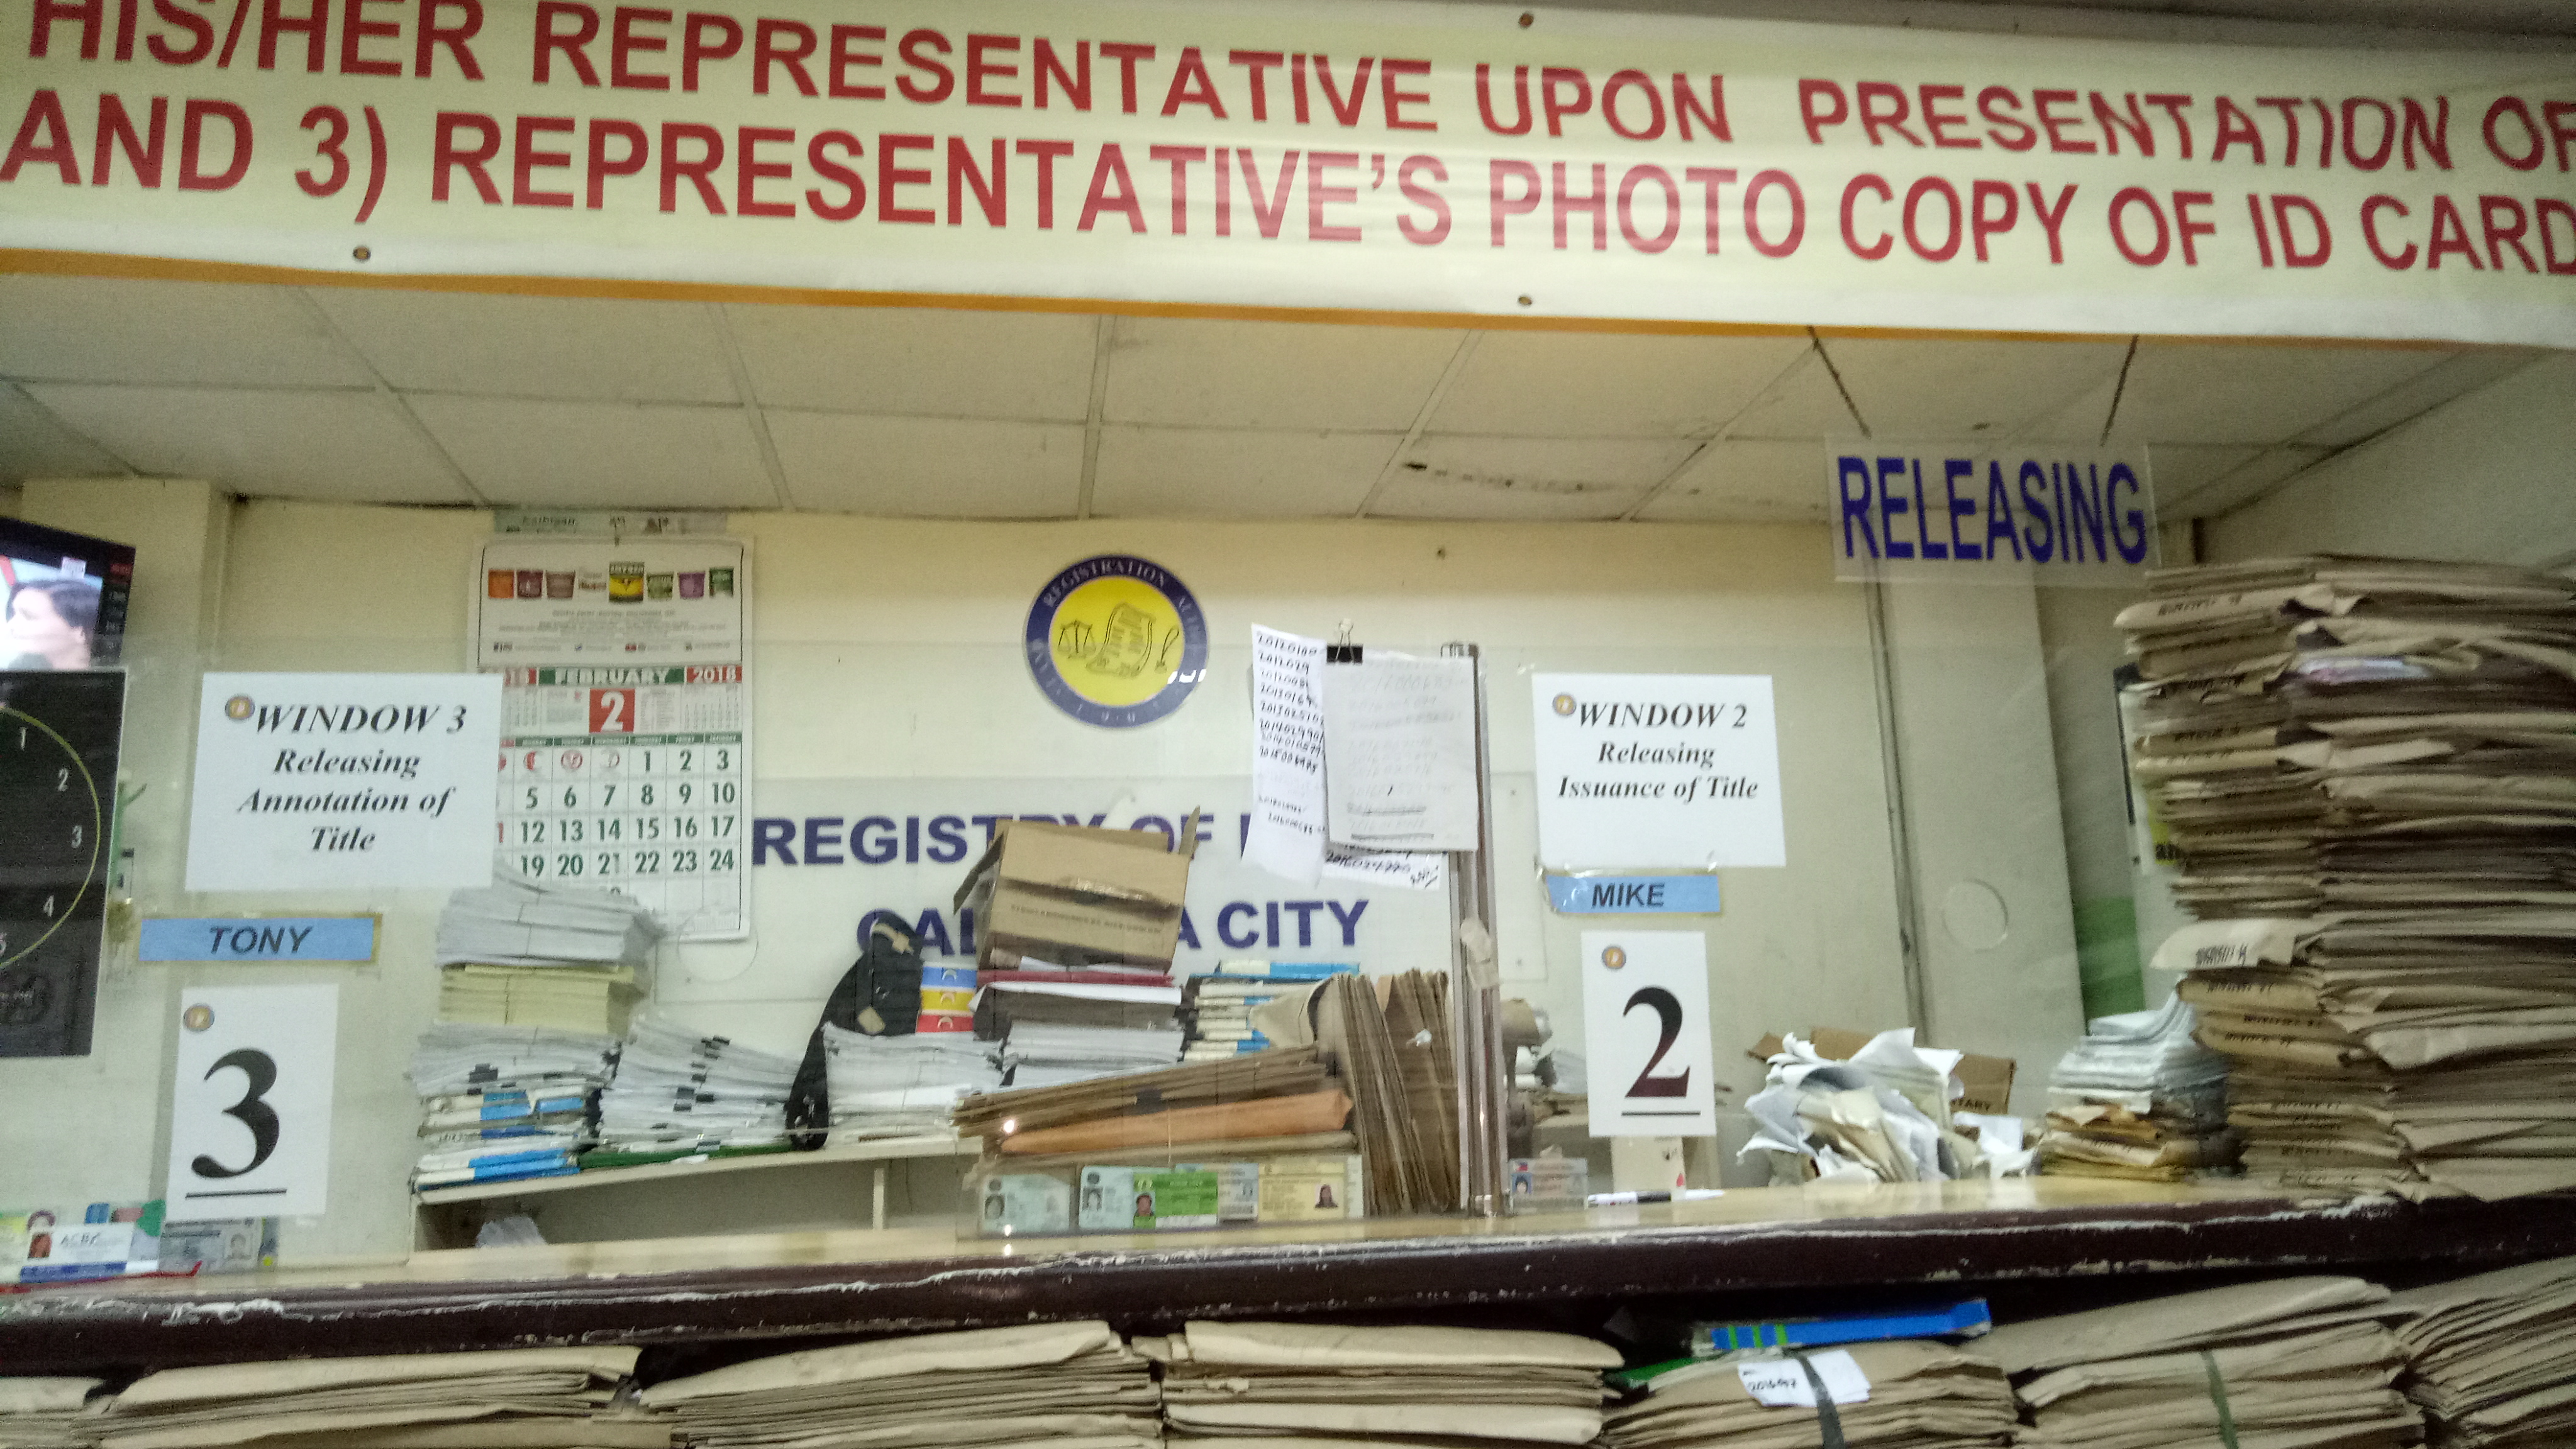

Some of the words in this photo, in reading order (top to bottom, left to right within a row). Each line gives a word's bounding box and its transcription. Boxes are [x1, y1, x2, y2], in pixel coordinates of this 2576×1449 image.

[30, 0, 485, 80] HIS/HER
[532, 0, 1440, 133] REPRESENTATIVE
[1474, 62, 1732, 143] UPON
[1798, 78, 2455, 170] PRESENTATION
[2483, 96, 2576, 172] OF
[0, 89, 253, 192] AND
[295, 104, 387, 223] 3)
[431, 111, 1451, 246] REPRESENTATIVE'S
[1489, 158, 1806, 260] PHOTO
[1840, 174, 2079, 265] COPY
[2108, 187, 2215, 267] OF
[2247, 193, 2332, 269] ID
[2360, 194, 2576, 275] CARD
[1838, 457, 2147, 564] RELEASING
[555, 666, 669, 686] FEBRUARY
[692, 665, 736, 683] 2018
[256, 703, 443, 735] WINDOW
[447, 704, 468, 735] 3
[601, 691, 625, 732] 2
[1580, 702, 1725, 730] WINDOW
[1732, 702, 1748, 730] 2
[19, 727, 26, 750] 1
[273, 749, 421, 779] Releasing
[644, 750, 650, 773] 1
[680, 750, 692, 772] 2
[718, 749, 729, 771] 3
[1597, 741, 1716, 769] Releasing
[58, 768, 69, 792] 2
[1558, 775, 1665, 799] Issuance
[1673, 774, 1702, 805] of
[1706, 775, 1759, 799] Title
[237, 787, 409, 813] Annotation
[418, 787, 456, 818] of
[526, 786, 538, 809] 5
[564, 786, 576, 808] 6
[604, 785, 616, 808] 7
[641, 783, 654, 806] 8
[679, 782, 692, 805] 9
[713, 782, 735, 804] 10
[72, 824, 82, 848] 3
[311, 826, 376, 852] Title
[521, 819, 545, 844] 12
[560, 819, 584, 842] 13
[597, 818, 621, 842] 14
[636, 817, 659, 840] 15
[674, 815, 697, 838] 16
[712, 814, 735, 838] 17
[521, 852, 544, 877] 19
[557, 852, 584, 877] 20
[598, 852, 620, 875] 21
[635, 850, 660, 874] 22
[672, 849, 698, 872] 23
[709, 848, 735, 871] 24
[43, 896, 54, 918] 4
[1591, 882, 1666, 908] MIKE
[1217, 899, 1370, 949] CITY
[209, 925, 313, 955] TONY
[1623, 985, 1690, 1098] 2
[191, 1047, 280, 1179] 3
